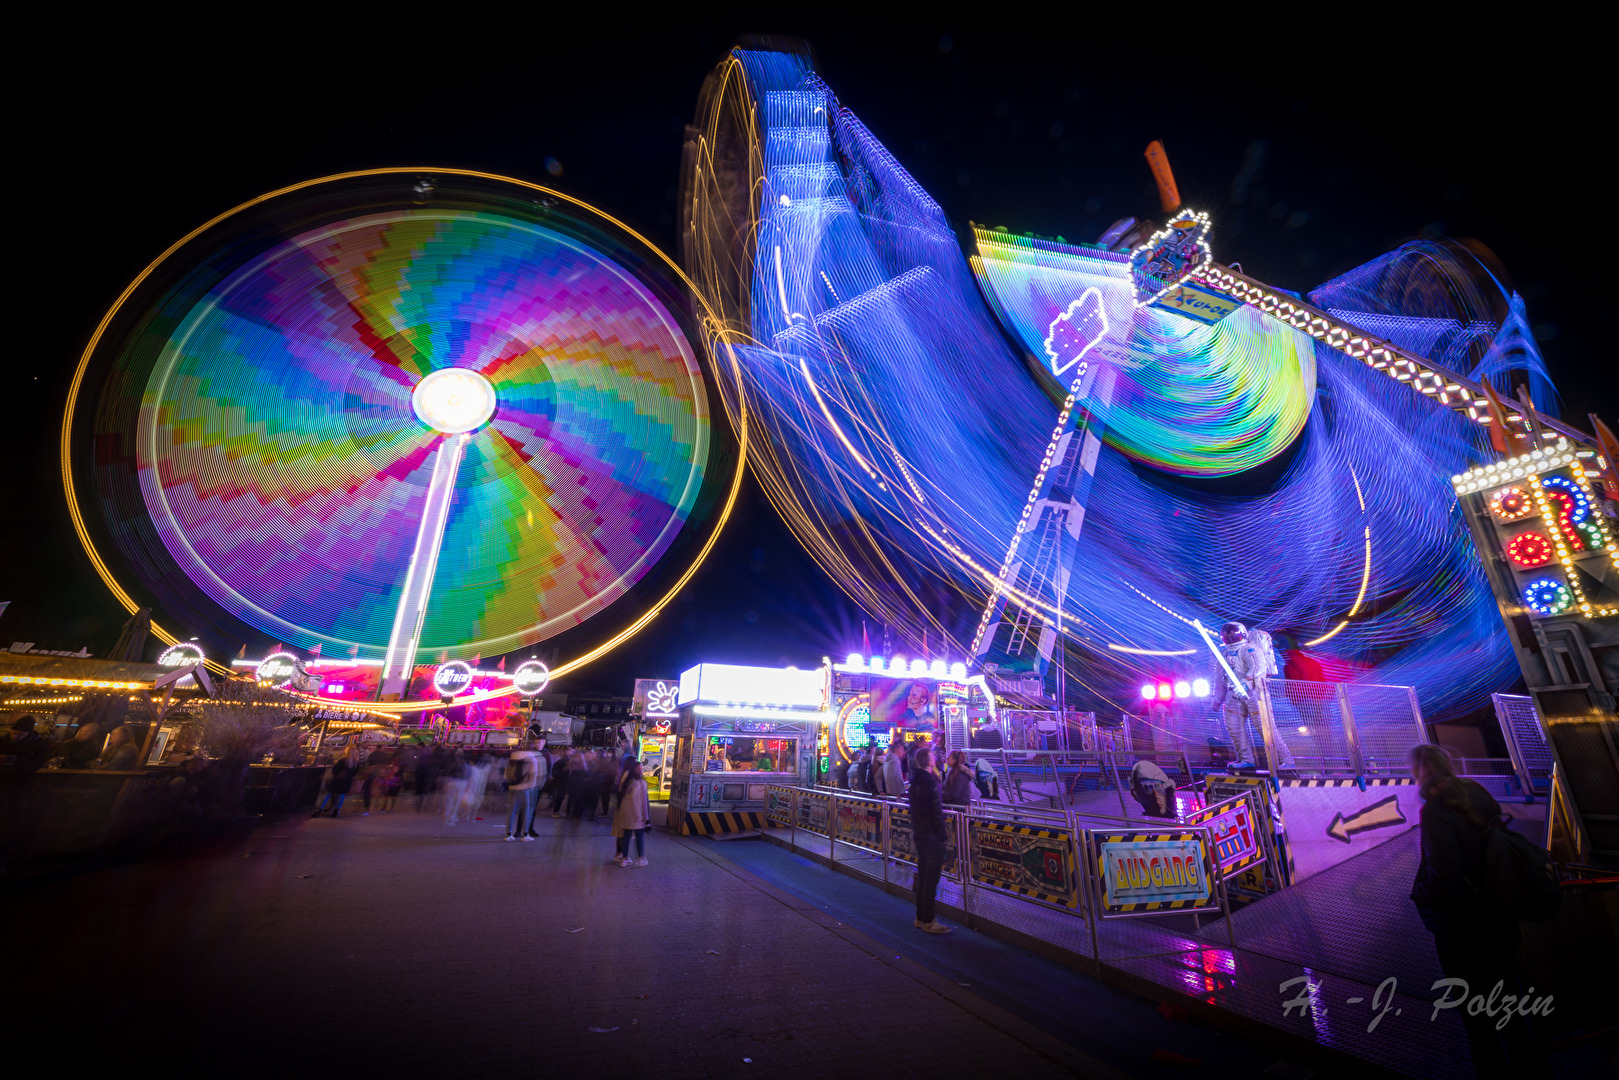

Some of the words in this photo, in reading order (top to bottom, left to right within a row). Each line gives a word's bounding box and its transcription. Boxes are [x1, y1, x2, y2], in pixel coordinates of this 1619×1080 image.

[978, 833, 1011, 848] DANGER
[980, 861, 1013, 877] DANGER
[1116, 855, 1199, 889] AUSGANG
